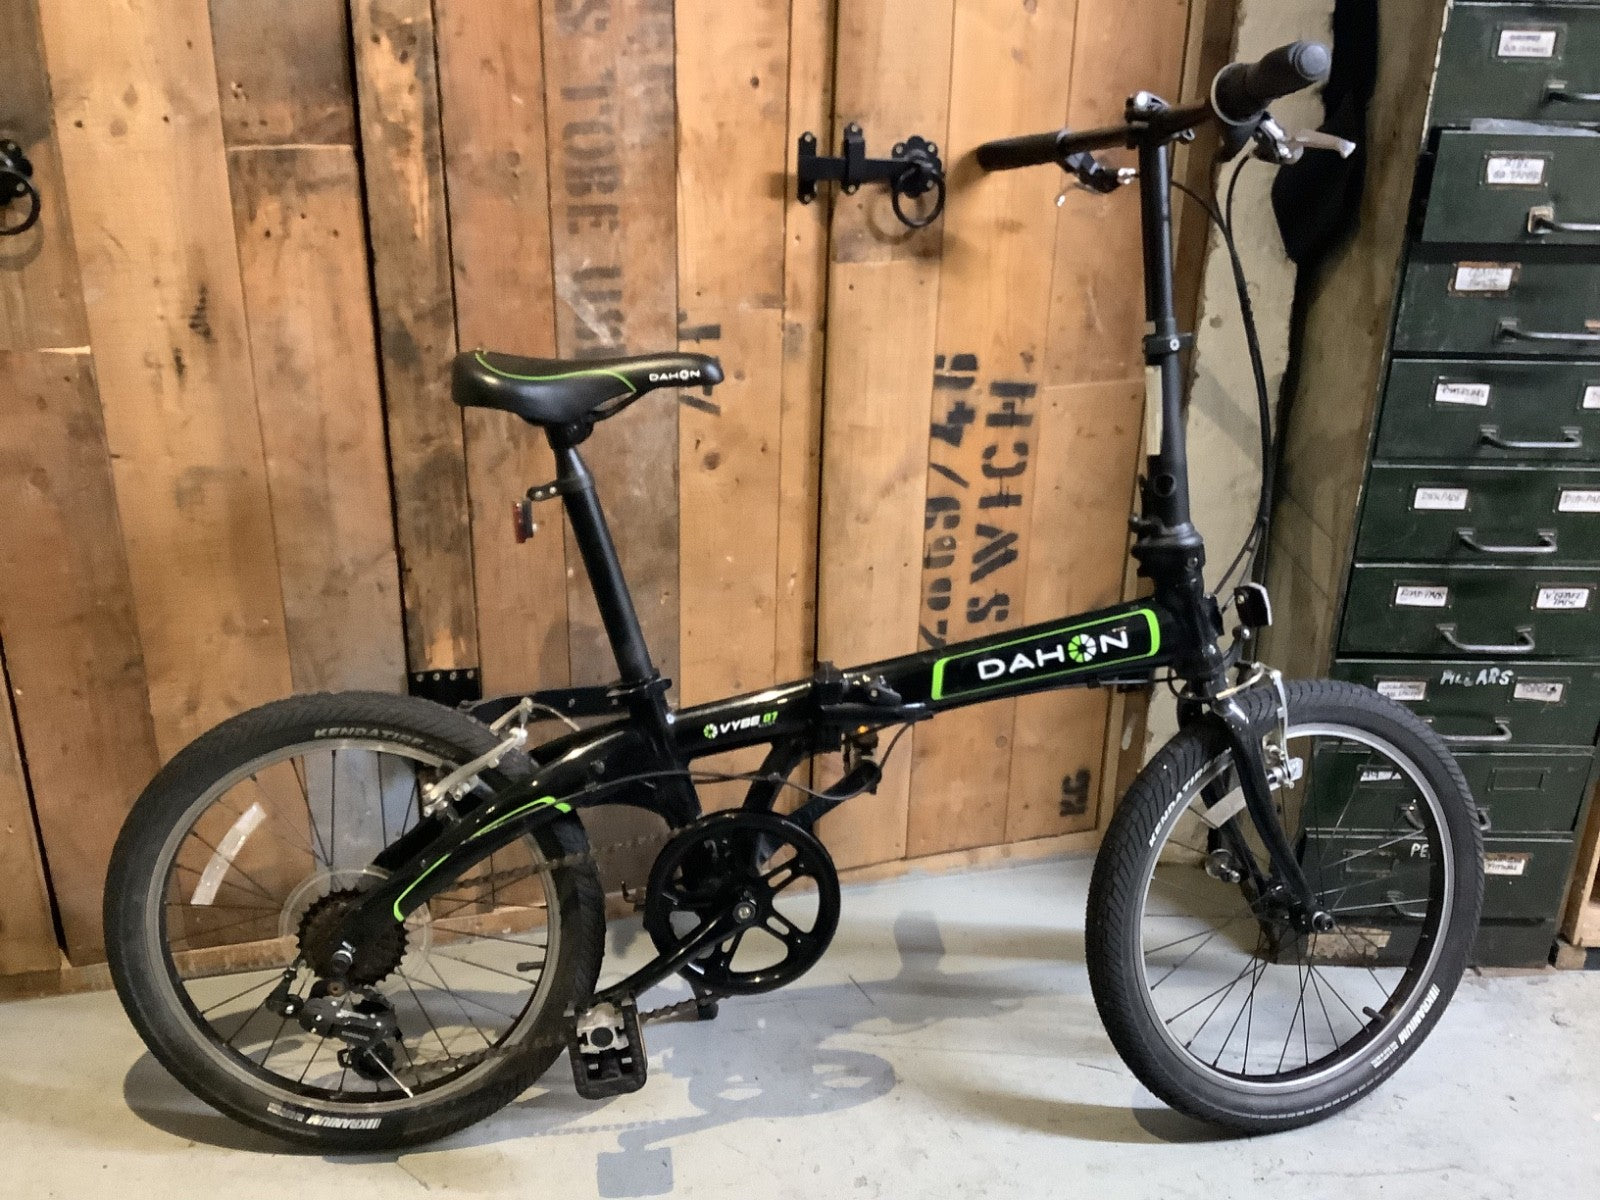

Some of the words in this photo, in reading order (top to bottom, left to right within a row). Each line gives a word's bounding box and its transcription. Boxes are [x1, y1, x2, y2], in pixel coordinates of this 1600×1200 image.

[648, 369, 701, 382] DAHON
[977, 630, 1129, 681] DAHON
[1410, 842, 1430, 859] PE
